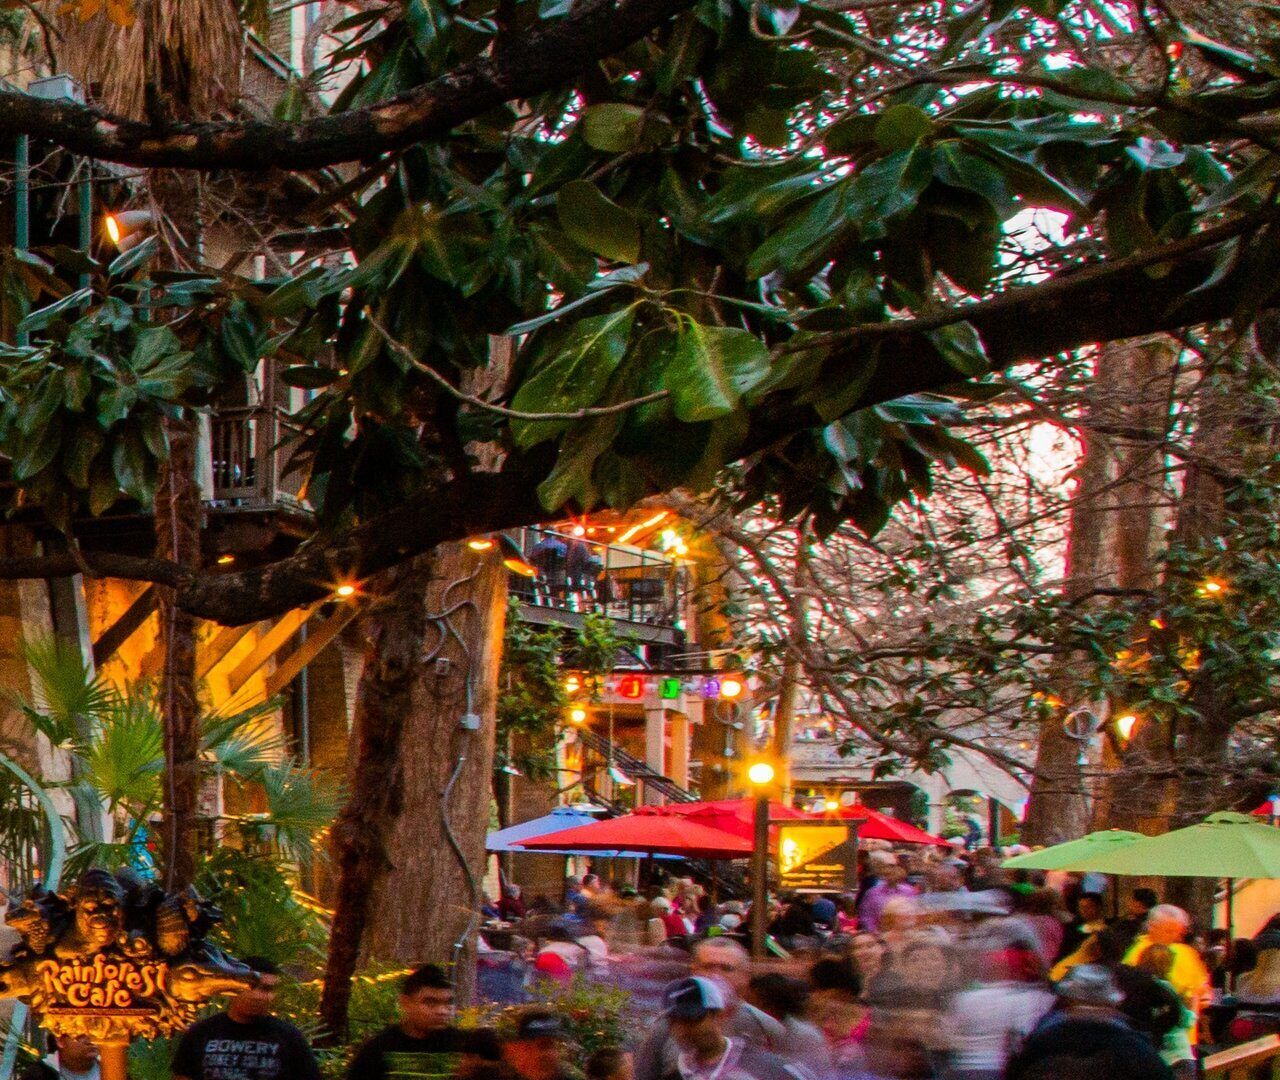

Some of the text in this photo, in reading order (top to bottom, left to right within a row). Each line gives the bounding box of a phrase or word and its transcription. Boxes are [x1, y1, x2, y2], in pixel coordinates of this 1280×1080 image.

[36, 953, 170, 997] Rainforest
[67, 979, 132, 1007] Cafe
[204, 1039, 280, 1056] BOWERY
